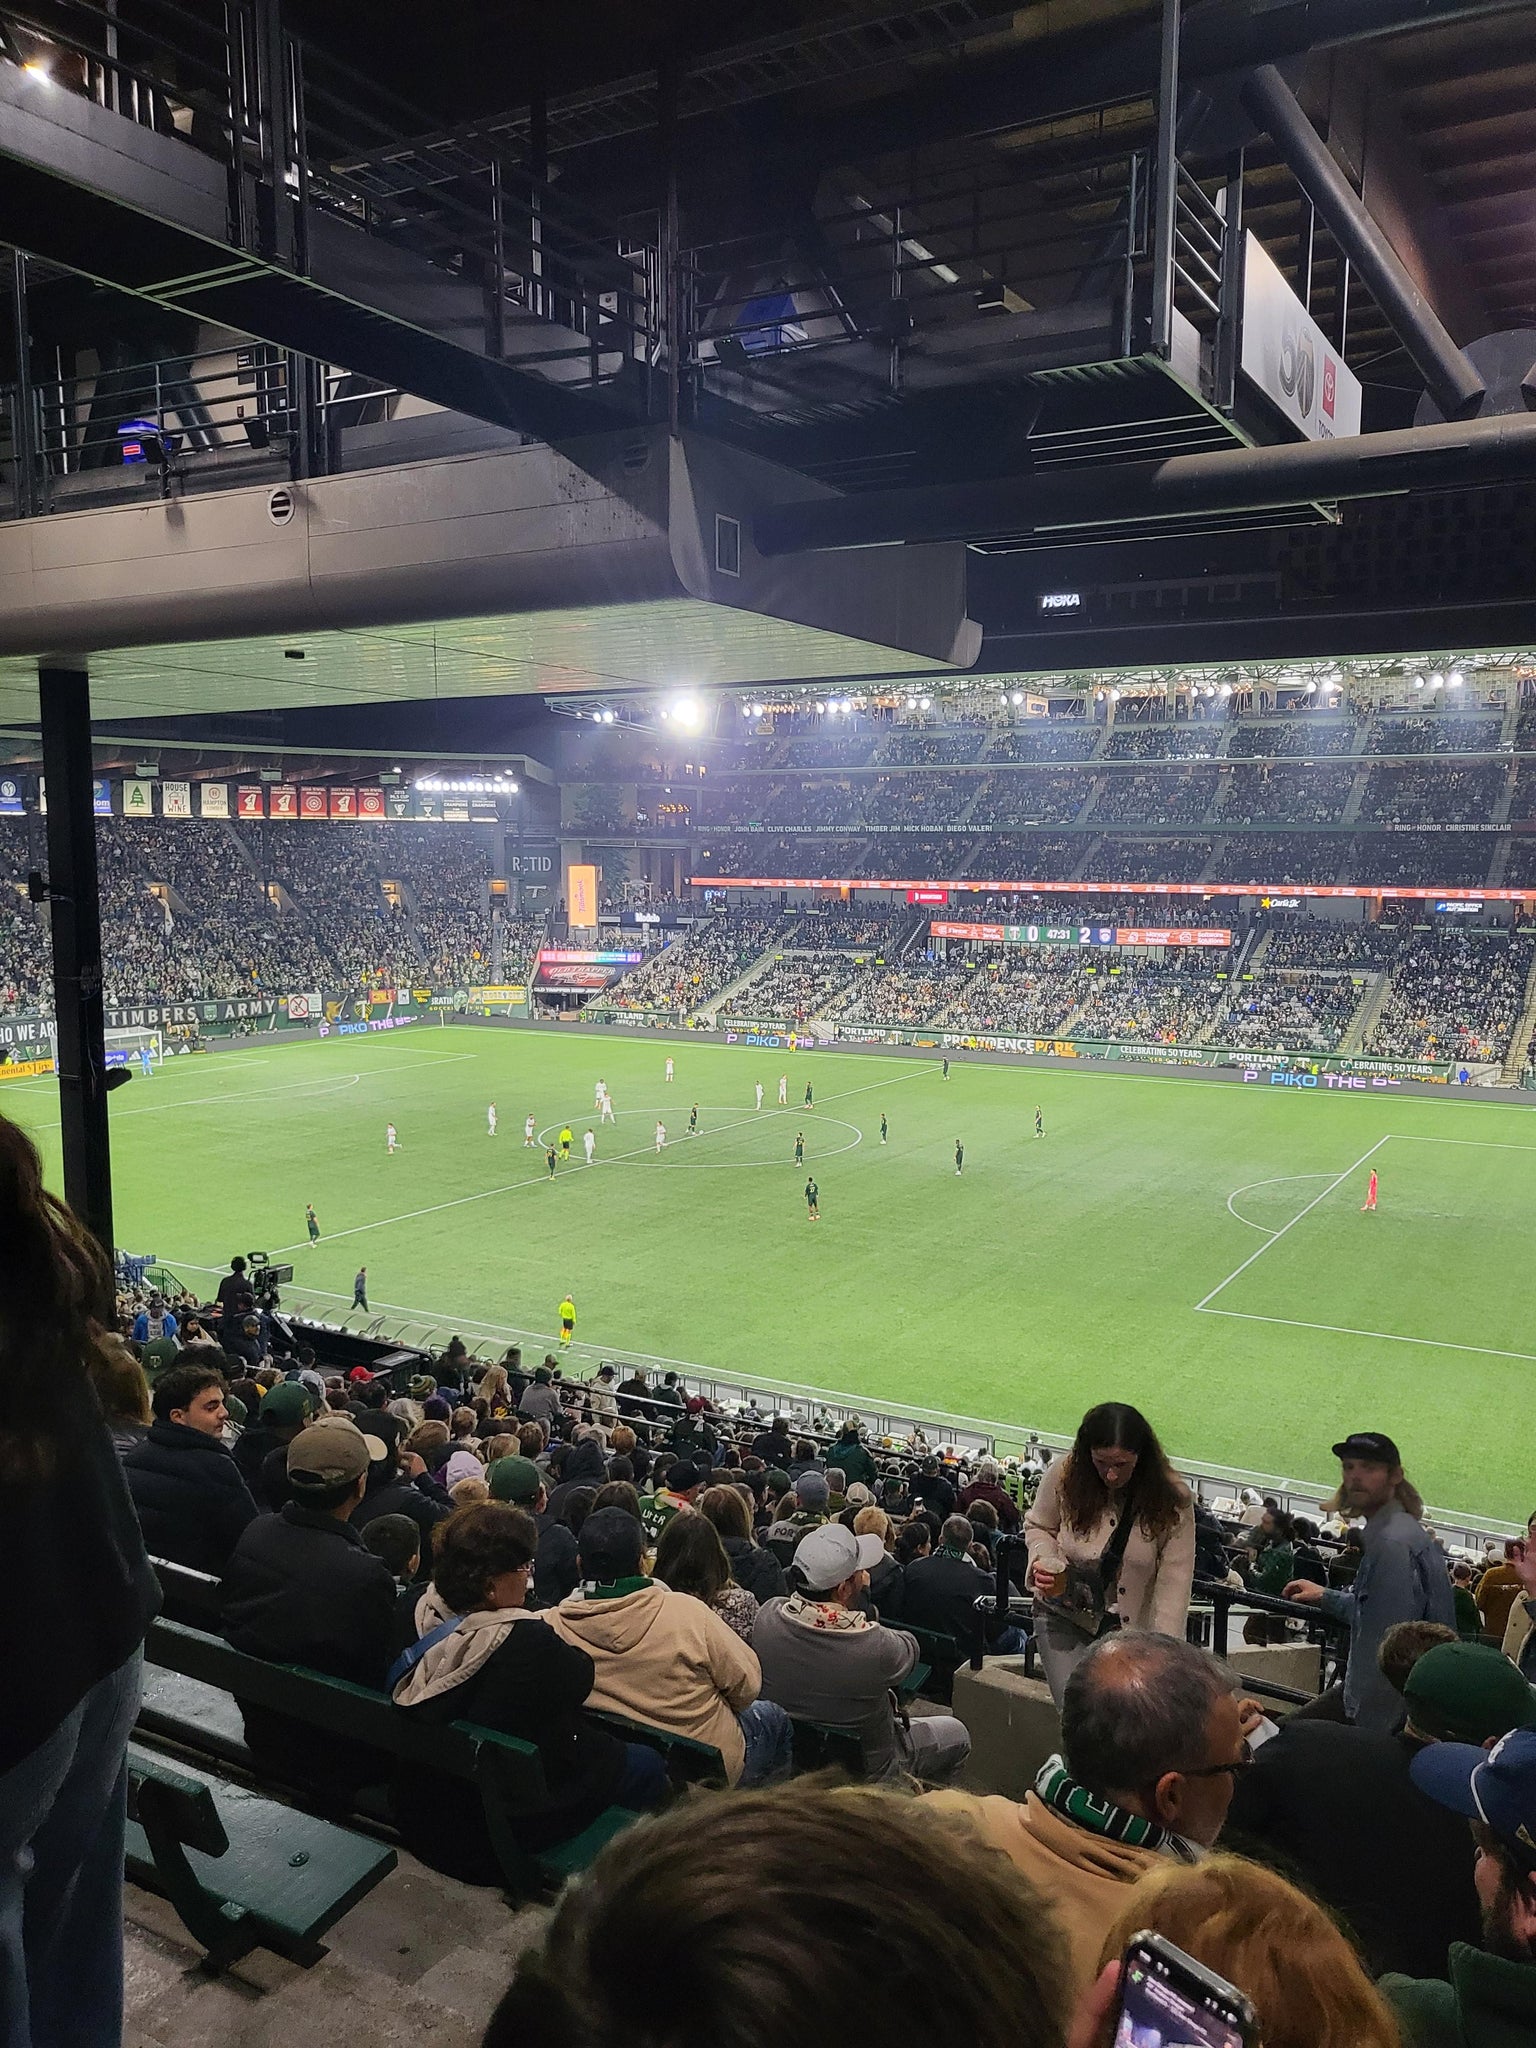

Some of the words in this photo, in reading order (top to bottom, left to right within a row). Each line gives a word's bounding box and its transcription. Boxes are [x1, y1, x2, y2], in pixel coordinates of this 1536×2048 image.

[1042, 593, 1080, 608] HOKA
[164, 783, 188, 792] HOUSE
[167, 804, 187, 814] WINE
[1394, 824, 1411, 832] RING
[1416, 824, 1441, 832] HONOR
[1445, 824, 1479, 832] CHRISTINE
[1480, 824, 1512, 832] SINCLAIR
[1028, 926, 1038, 942] 0
[1047, 929, 1070, 939] 47:31
[1080, 927, 1091, 943] 2
[571, 966, 615, 975] TRAPPER
[108, 1006, 197, 1026] TIMBERS
[224, 999, 275, 1015] ARMY
[17, 1024, 36, 1041] WE
[339, 1022, 368, 1035] PIKO
[369, 1018, 394, 1031] THE
[840, 1026, 886, 1037] PORTLAND
[746, 1035, 780, 1047] PIKO
[1120, 1045, 1166, 1056] CELEBRATING
[1167, 1049, 1178, 1057] 50
[1179, 1050, 1202, 1058] YEARS
[1229, 1052, 1290, 1064] PORTLAND
[1393, 1064, 1405, 1072] 50
[1406, 1065, 1433, 1074] YEARS
[1271, 1072, 1318, 1087] PIKO
[1323, 1075, 1366, 1088] THE
